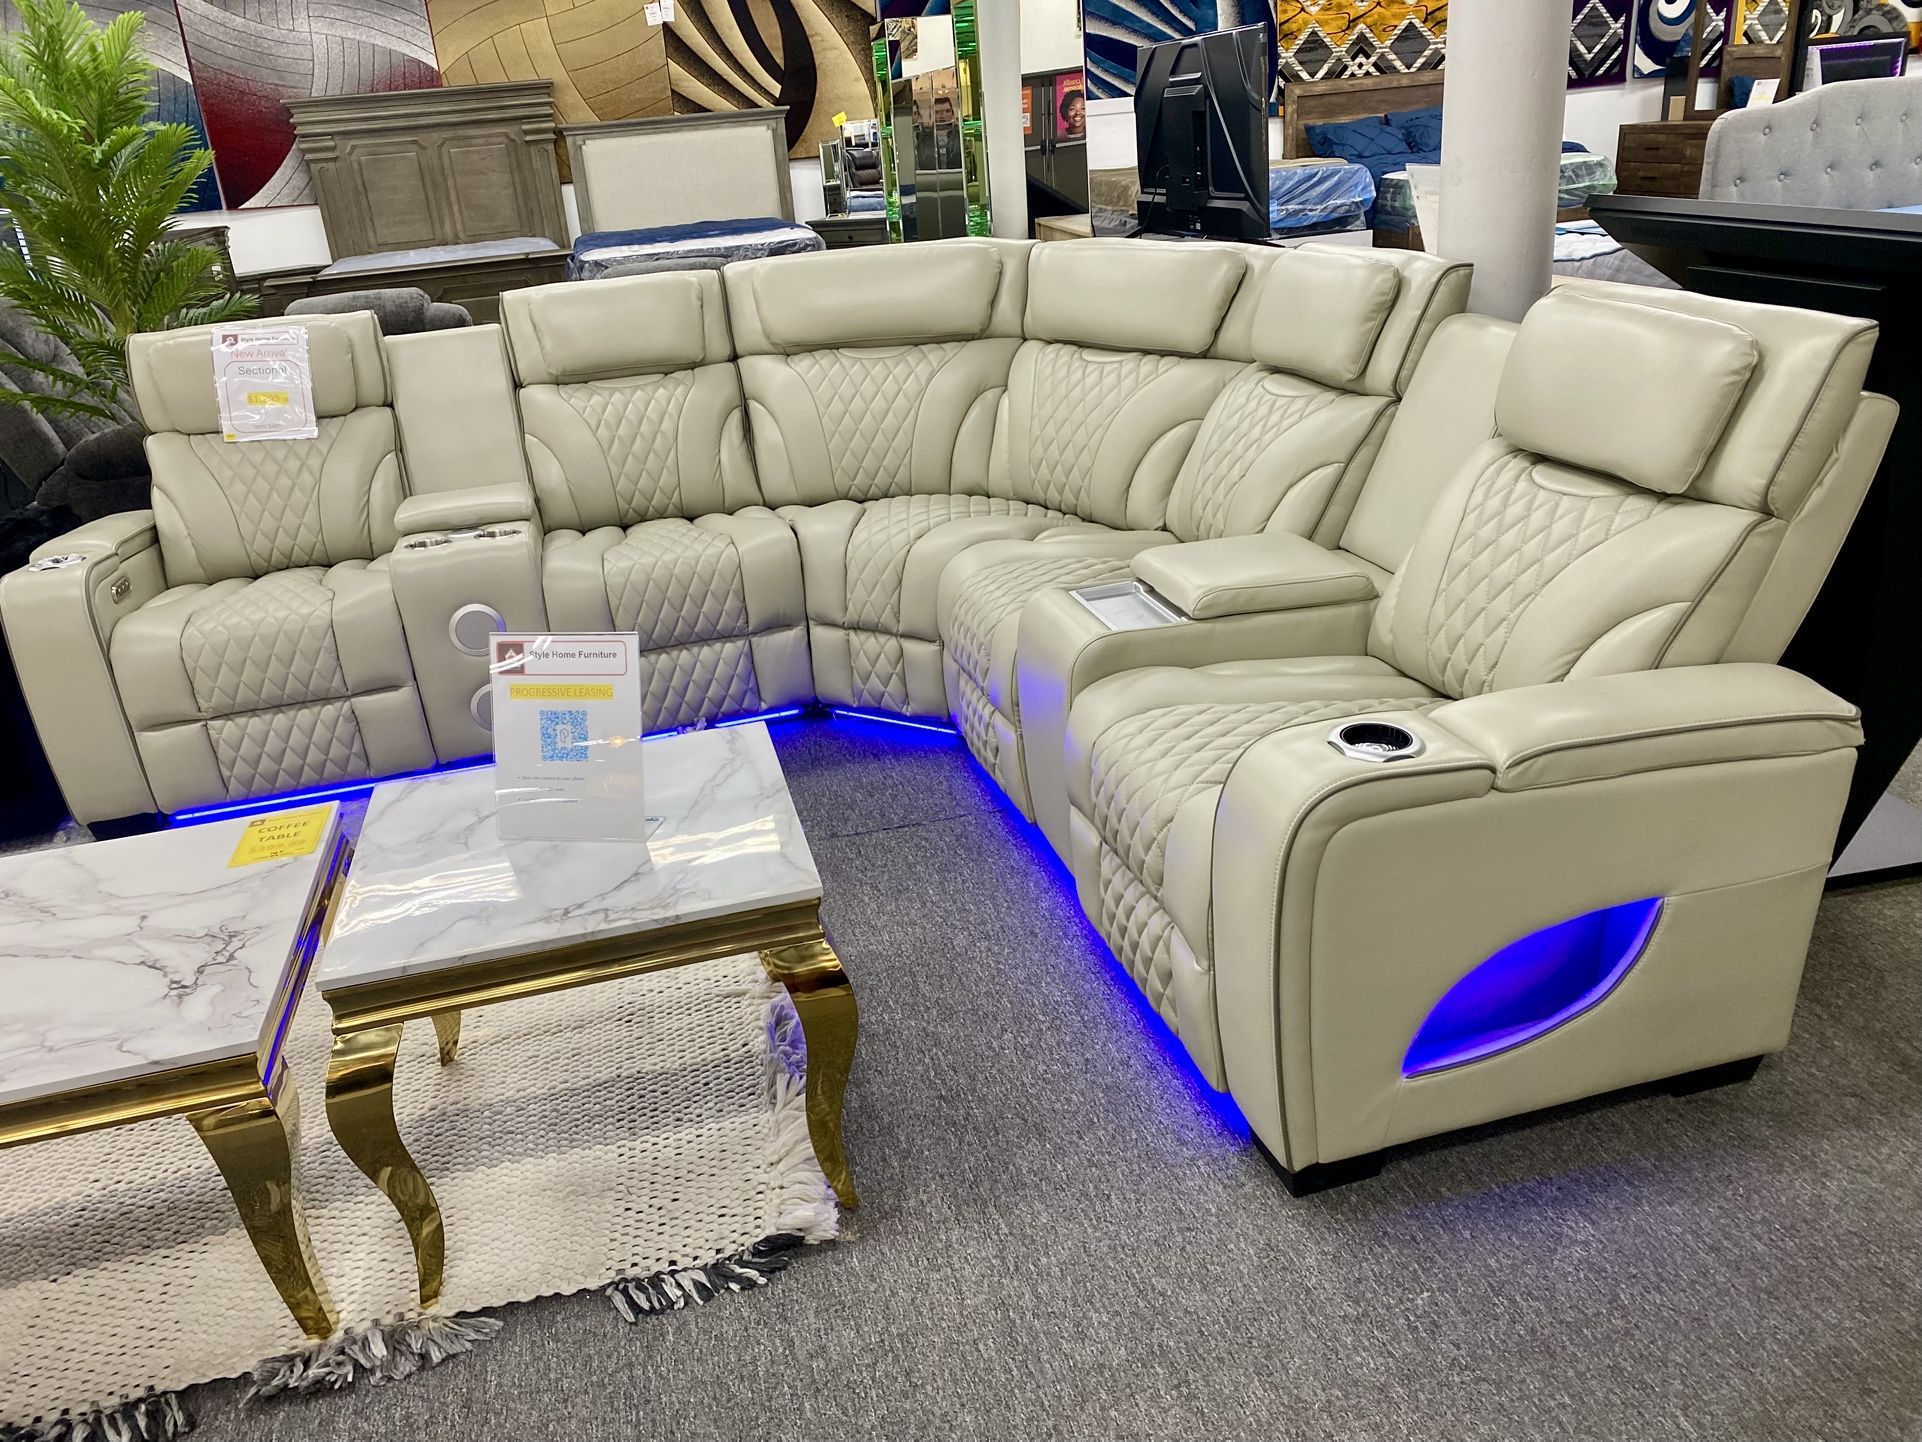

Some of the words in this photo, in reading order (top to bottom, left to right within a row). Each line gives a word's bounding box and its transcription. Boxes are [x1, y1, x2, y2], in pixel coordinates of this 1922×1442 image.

[230, 350, 254, 358] New
[256, 348, 288, 357] Arrival
[529, 650, 550, 661] Style
[552, 650, 576, 659] Home
[578, 650, 617, 659] Furniture
[509, 687, 571, 698] PROGRESSIVE
[574, 687, 614, 698] LEASING
[258, 820, 310, 834] COFFEE
[259, 831, 302, 842] TABLE
